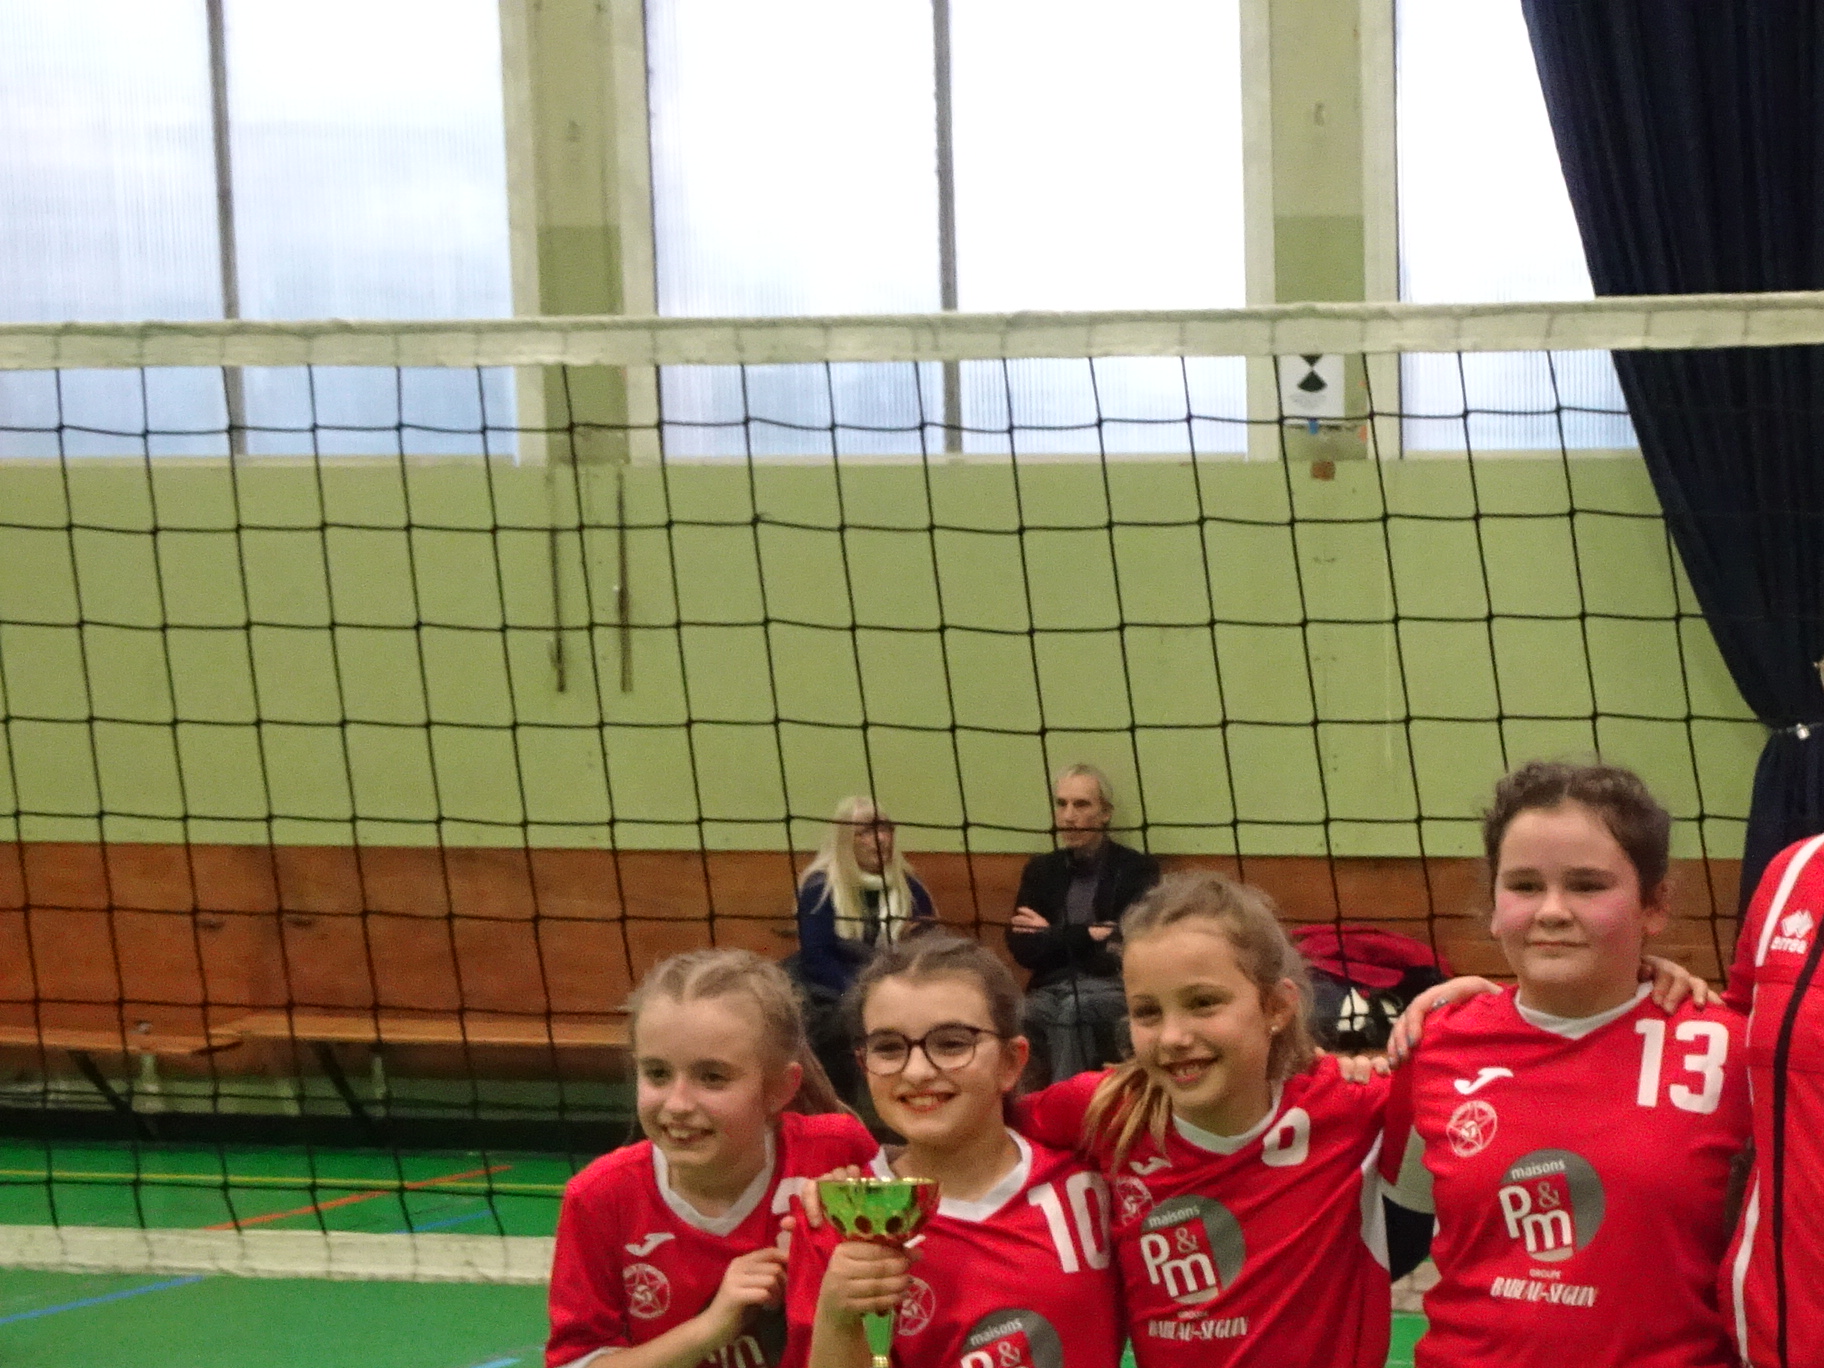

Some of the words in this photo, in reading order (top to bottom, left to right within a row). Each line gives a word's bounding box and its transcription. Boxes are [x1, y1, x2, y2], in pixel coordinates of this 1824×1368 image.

[1635, 1018, 1729, 1115] 13
[1511, 1159, 1566, 1180] maisons
[1027, 1171, 1110, 1273] 10
[1148, 1205, 1200, 1228] maisons
[970, 1317, 1023, 1347] maisons
